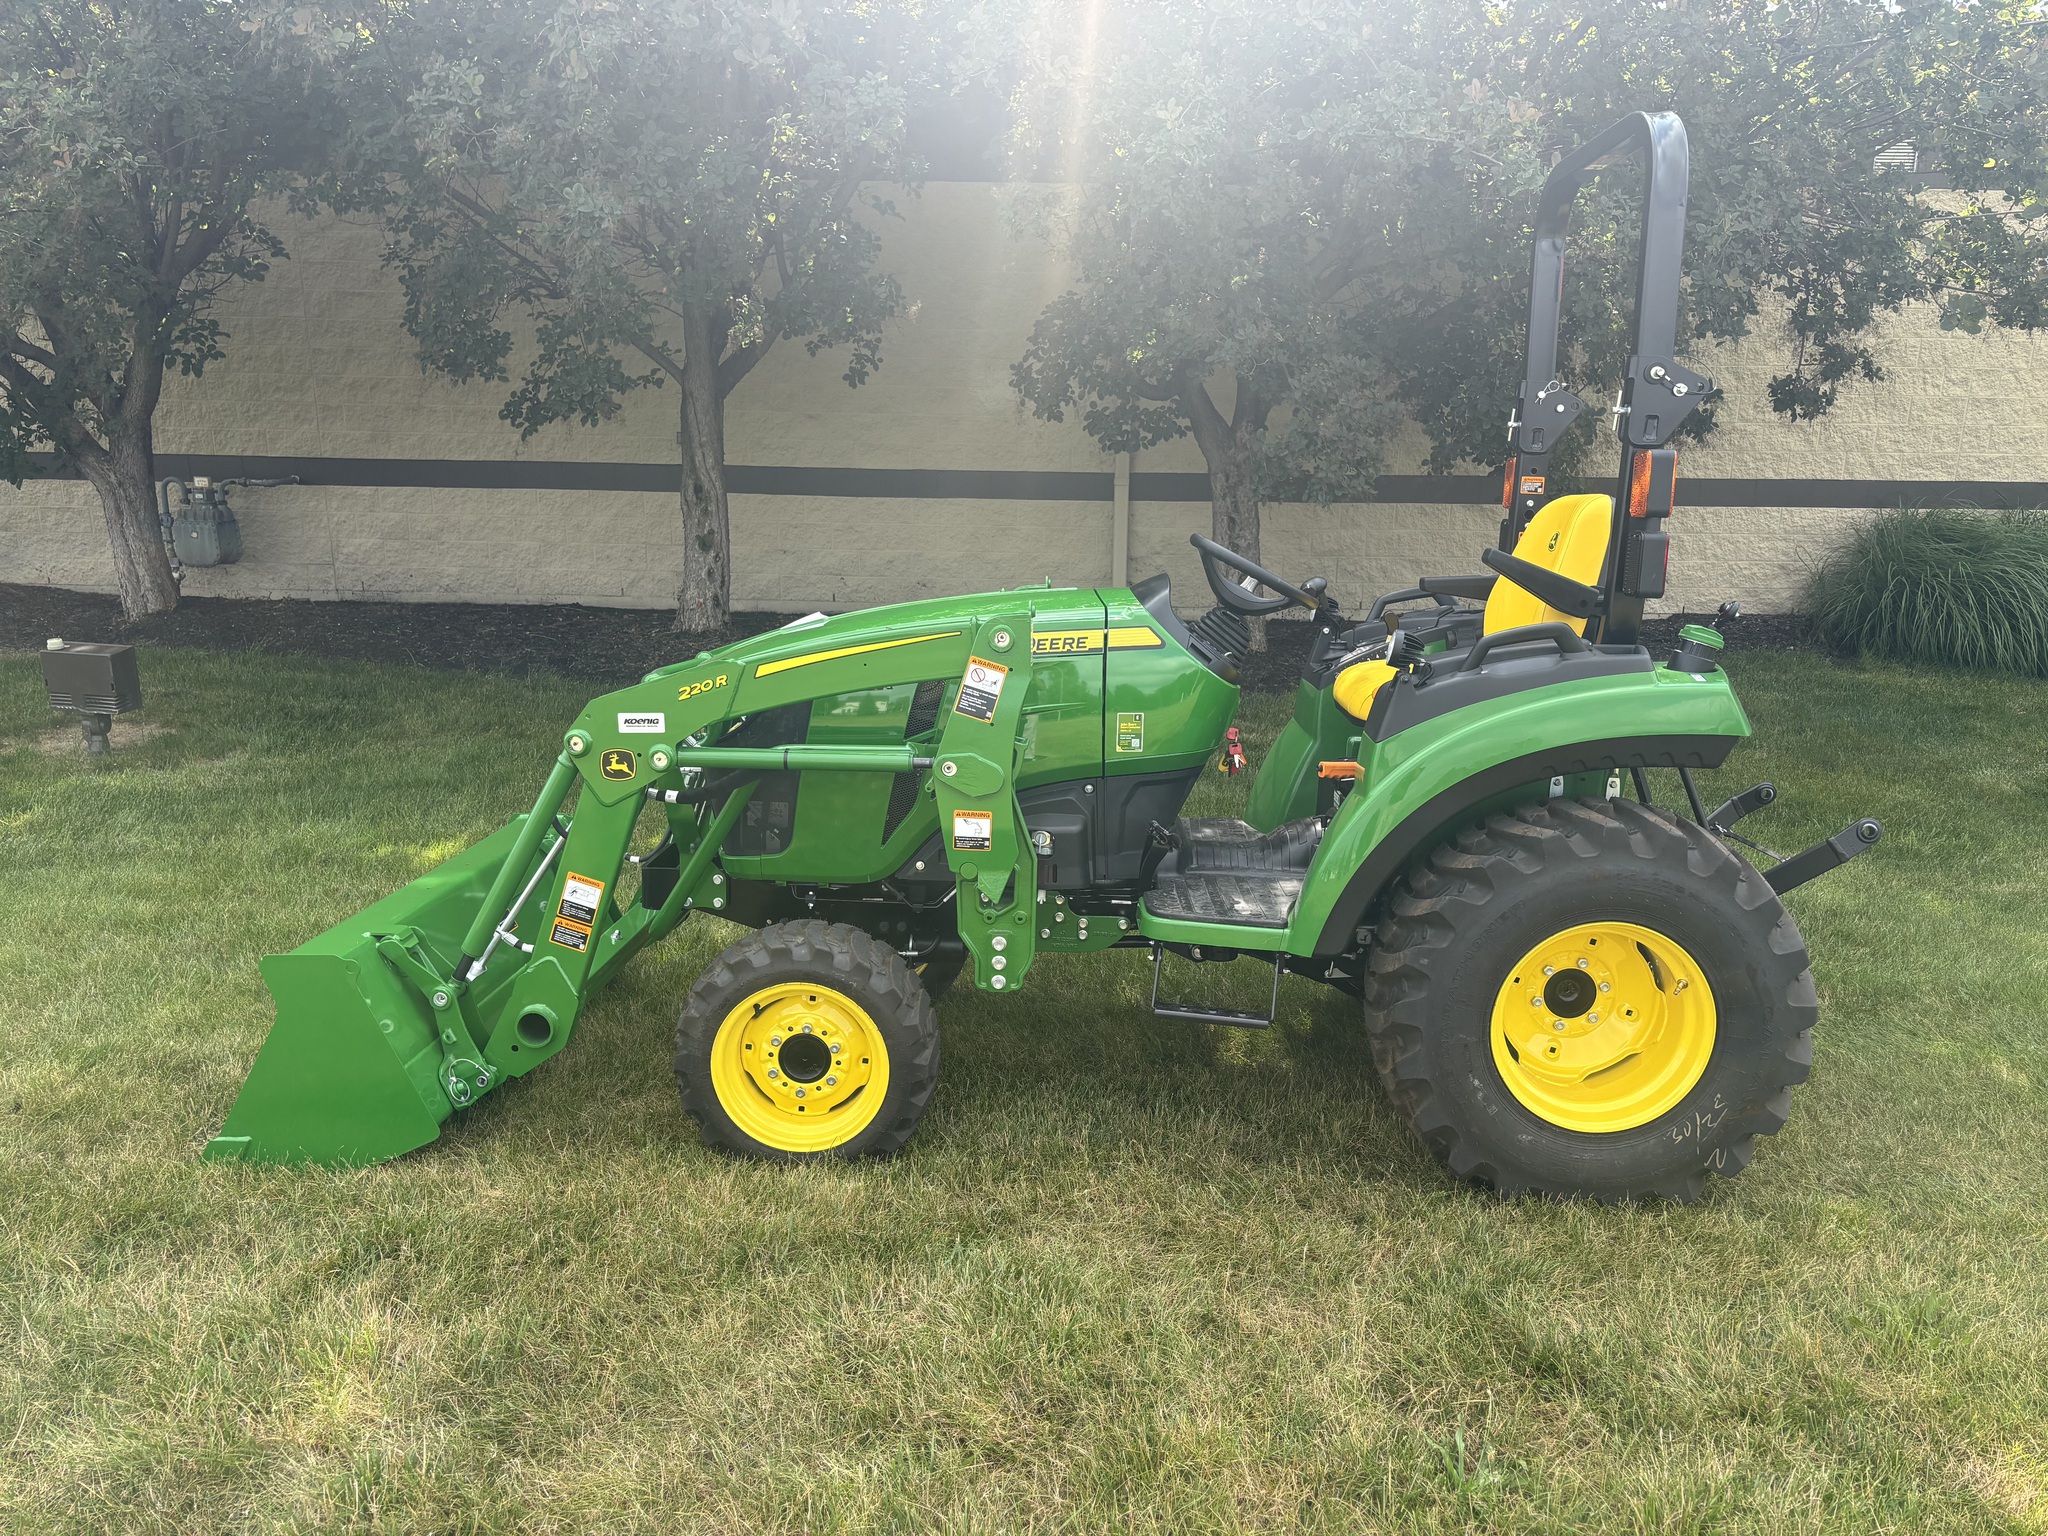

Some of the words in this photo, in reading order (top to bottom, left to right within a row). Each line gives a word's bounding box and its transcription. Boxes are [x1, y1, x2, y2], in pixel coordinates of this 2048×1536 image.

[977, 659, 1006, 672] WARNING
[678, 680, 713, 700] 220
[715, 675, 728, 688] R
[578, 876, 600, 887] WARNING
[565, 921, 588, 932] WARNING
